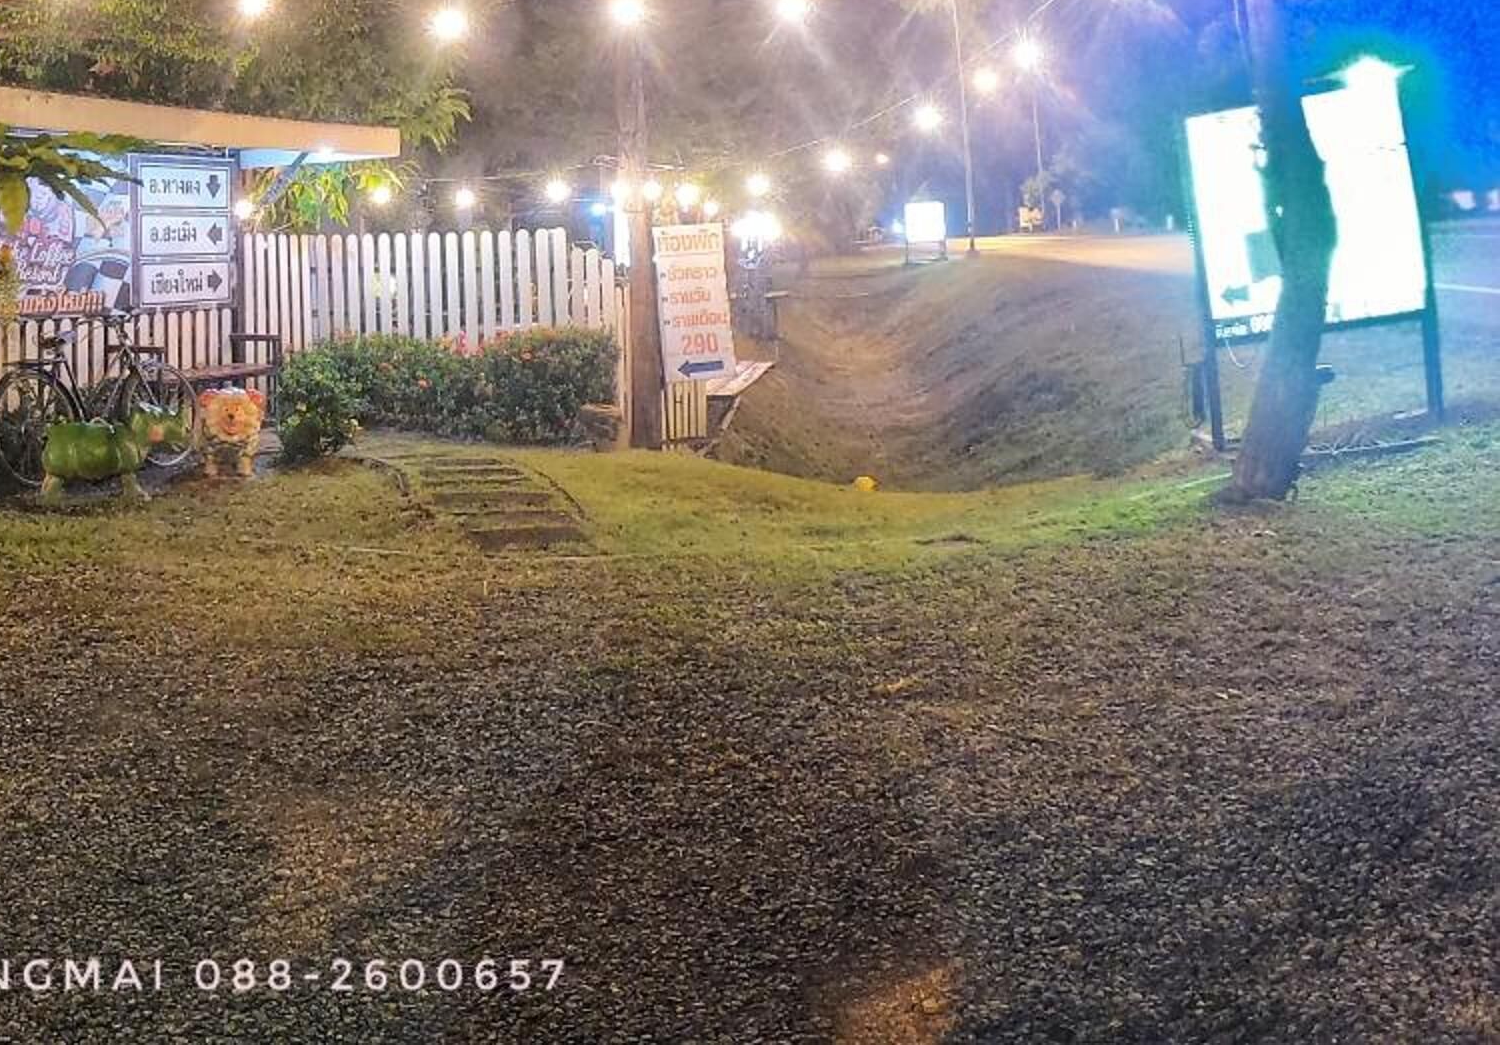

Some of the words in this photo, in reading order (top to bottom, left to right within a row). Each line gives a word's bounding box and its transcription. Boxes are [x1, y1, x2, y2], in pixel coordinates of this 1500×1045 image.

[150, 268, 204, 295] เชียงใหม่
[681, 332, 719, 356] 290
